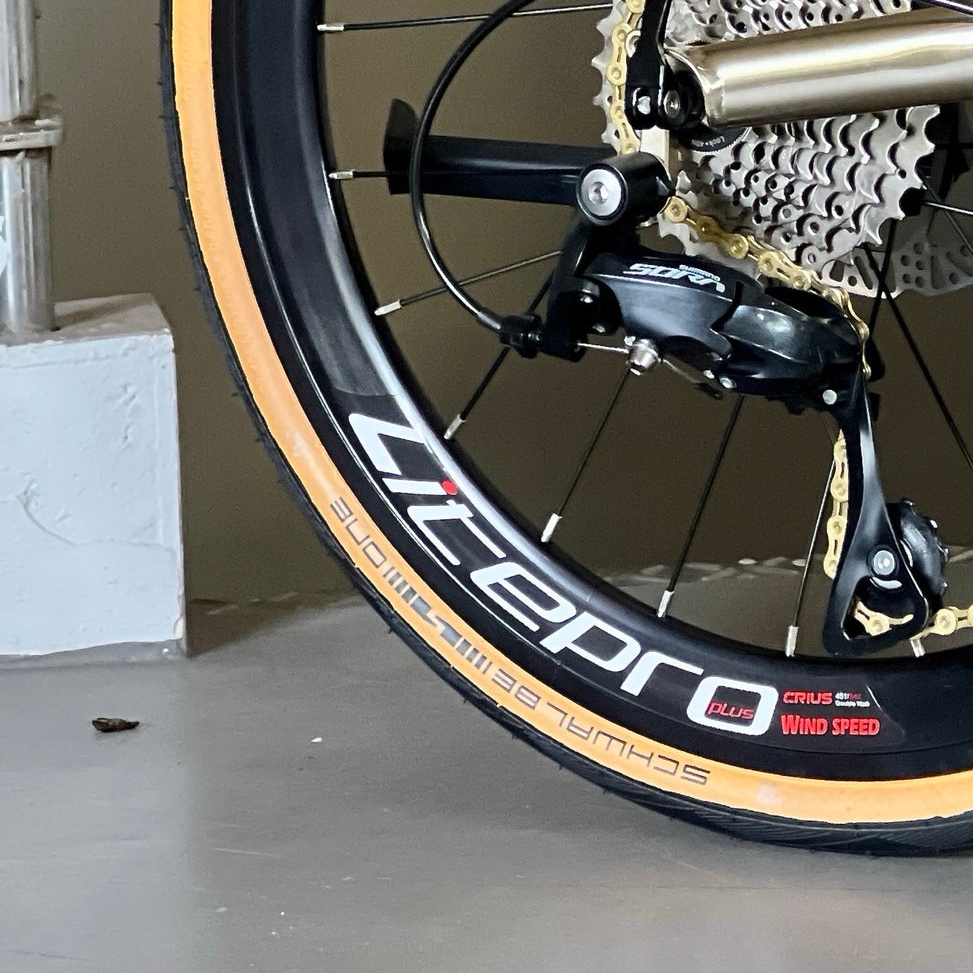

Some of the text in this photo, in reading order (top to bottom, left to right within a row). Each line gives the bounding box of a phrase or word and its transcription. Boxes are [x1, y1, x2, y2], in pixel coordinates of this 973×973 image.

[329, 496, 386, 570] ONE
[782, 690, 833, 705] CRIUS
[492, 667, 711, 785] SCHWALBE
[831, 717, 881, 736] SPEED
